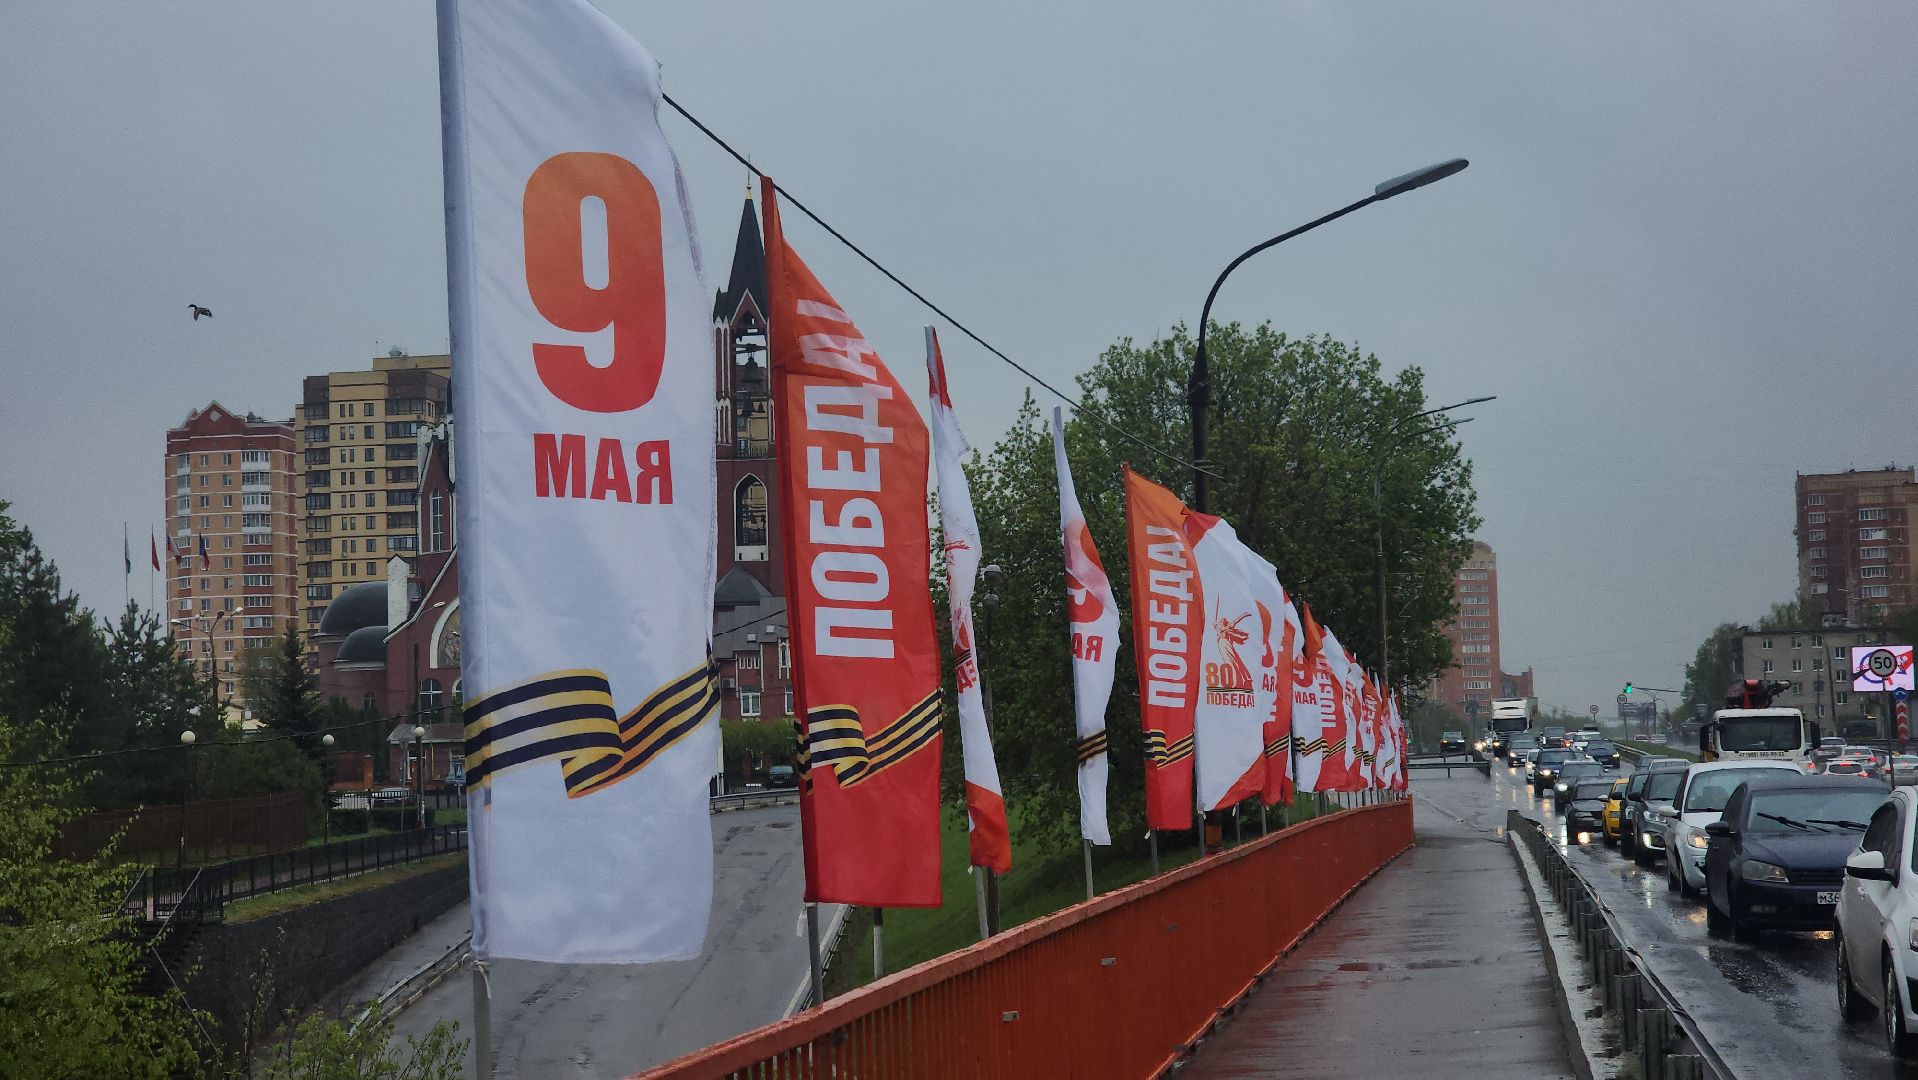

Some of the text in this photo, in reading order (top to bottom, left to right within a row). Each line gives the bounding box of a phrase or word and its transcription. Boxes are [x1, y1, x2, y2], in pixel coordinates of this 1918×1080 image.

[522, 152, 666, 413] 9
[533, 433, 674, 505] МАЯ
[1146, 525, 1194, 708] ПОБЕДА!
[1071, 632, 1104, 663] АЯ
[1205, 662, 1235, 689] 80
[1873, 656, 1893, 670] 50
[1206, 692, 1255, 709] ПОБЕДА!
[1818, 892, 1840, 904] М36
